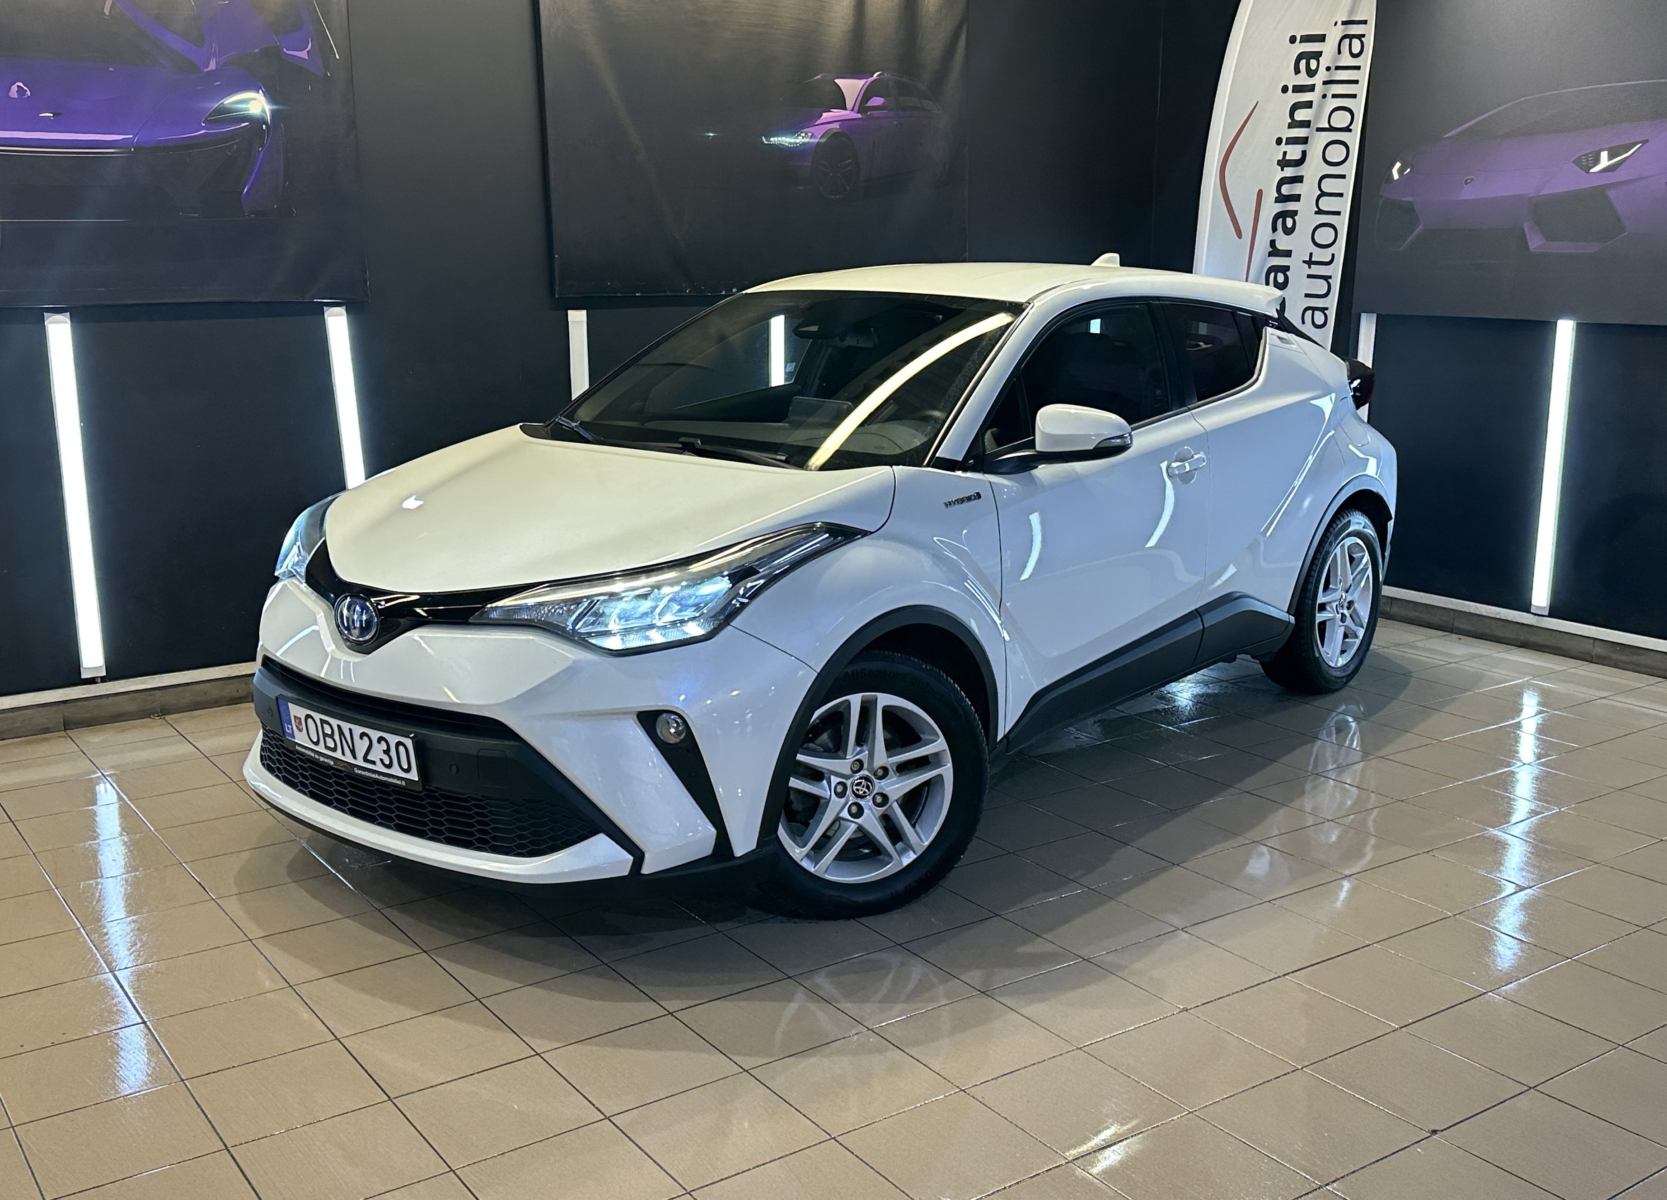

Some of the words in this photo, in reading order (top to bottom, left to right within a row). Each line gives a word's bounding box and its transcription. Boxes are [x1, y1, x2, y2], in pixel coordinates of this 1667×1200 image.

[1264, 33, 1327, 316] arantiniai
[1301, 19, 1369, 329] automobiliai
[304, 713, 412, 774] OBN230
[843, 668, 945, 700] AllSeasonContact
